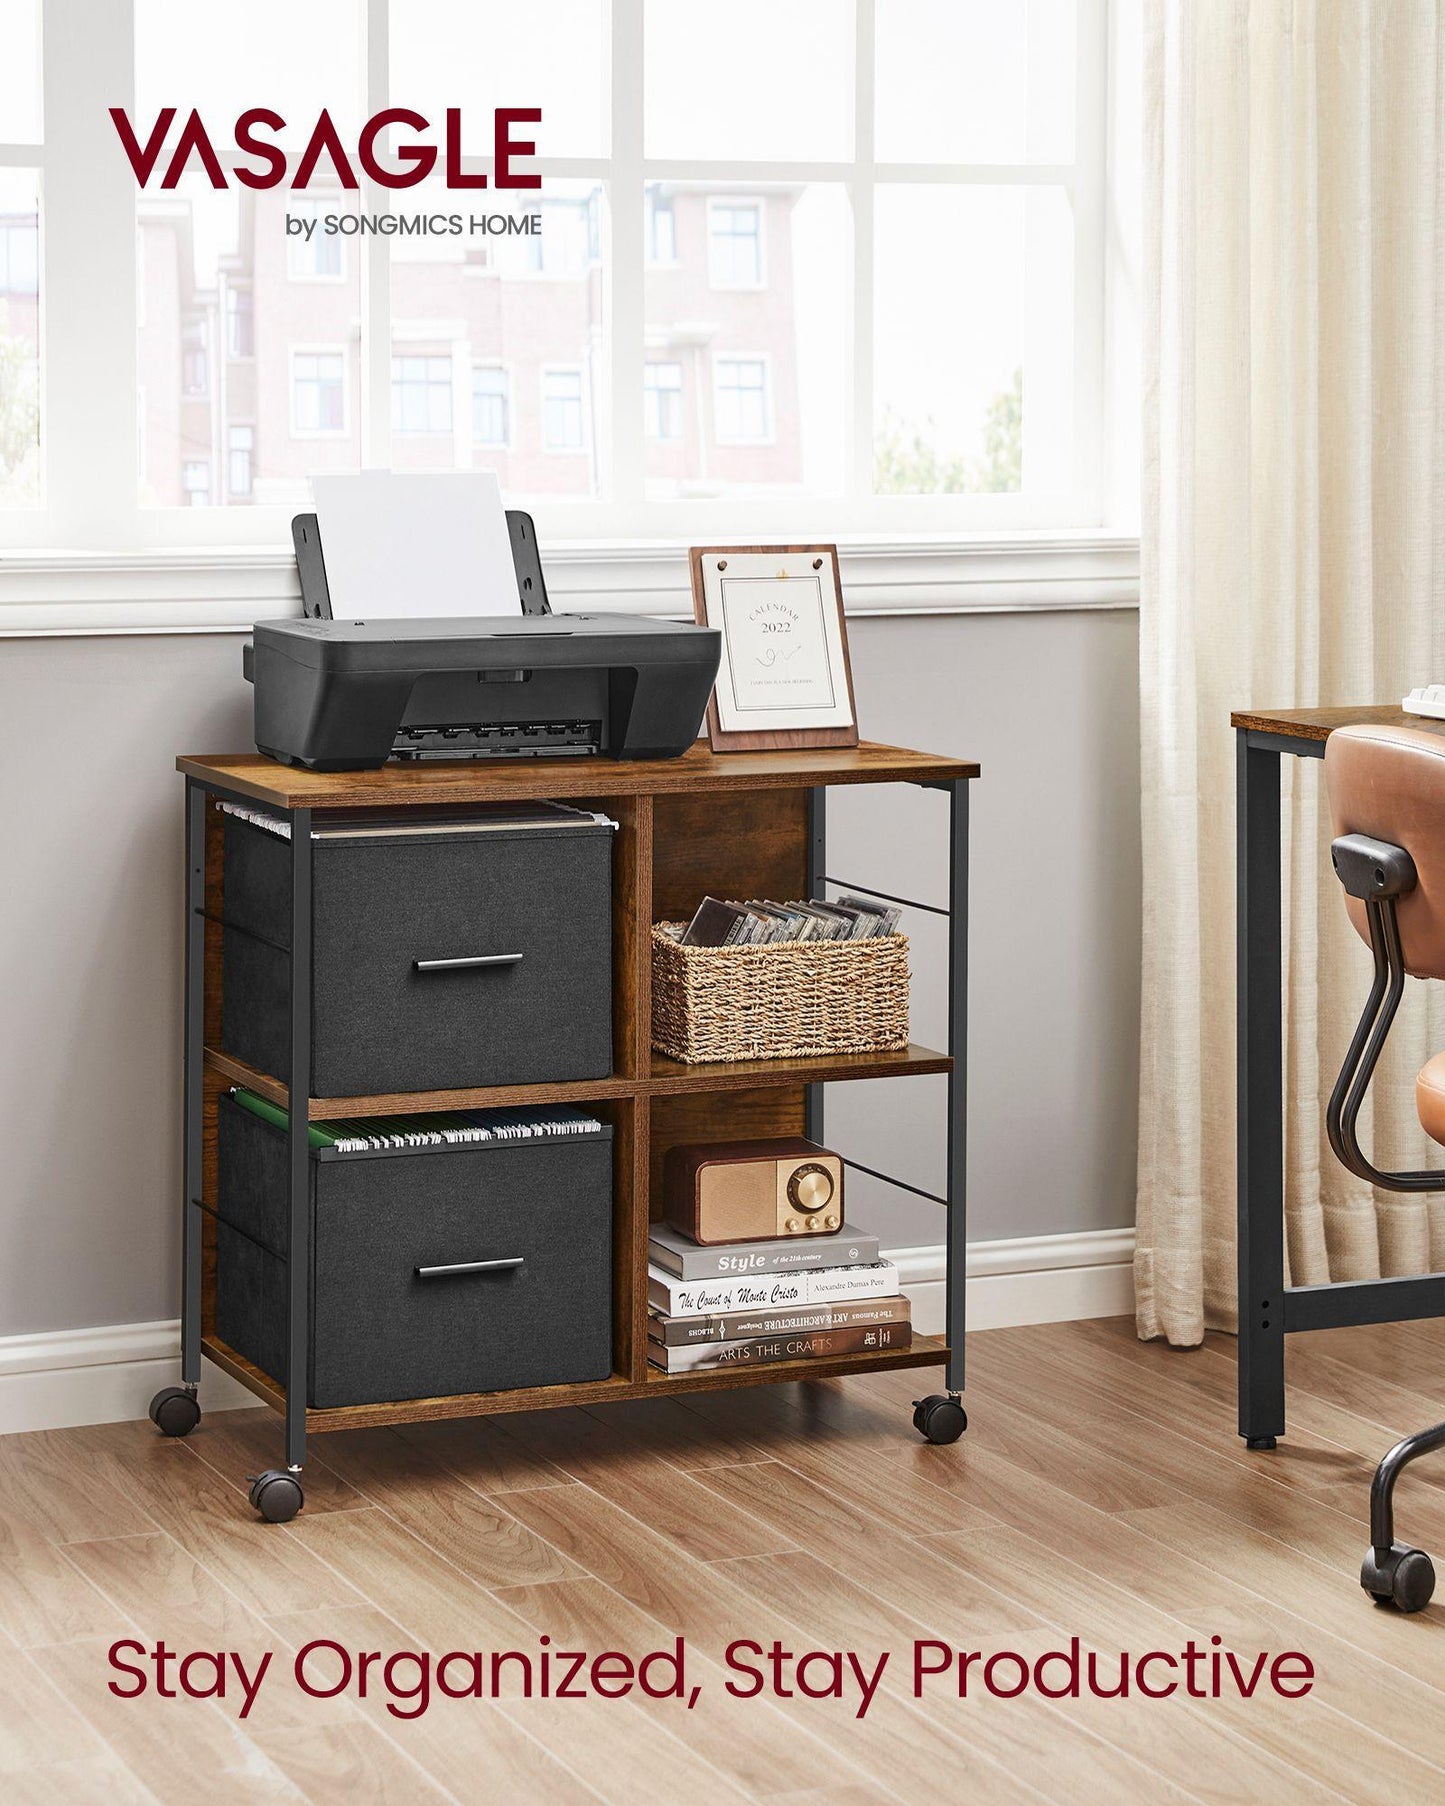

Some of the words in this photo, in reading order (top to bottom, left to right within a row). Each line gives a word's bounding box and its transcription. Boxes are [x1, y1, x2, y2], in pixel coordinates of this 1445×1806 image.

[749, 602, 799, 622] CALENDAR
[761, 622, 791, 633] 2022
[718, 1254, 766, 1272] Style
[813, 1282, 846, 1293] Alexandre
[847, 1280, 870, 1290] Dumas
[678, 1292, 694, 1309] The
[697, 1290, 722, 1310] Count
[724, 1290, 733, 1309] of
[737, 1288, 767, 1304] Monte
[770, 1284, 798, 1304] Cristo
[852, 1311, 879, 1320] Famous
[880, 1310, 893, 1318] The
[737, 1323, 763, 1331] Designer
[719, 1347, 750, 1361] ARTS
[756, 1344, 781, 1357] THE
[787, 1338, 834, 1354] CRAFTS
